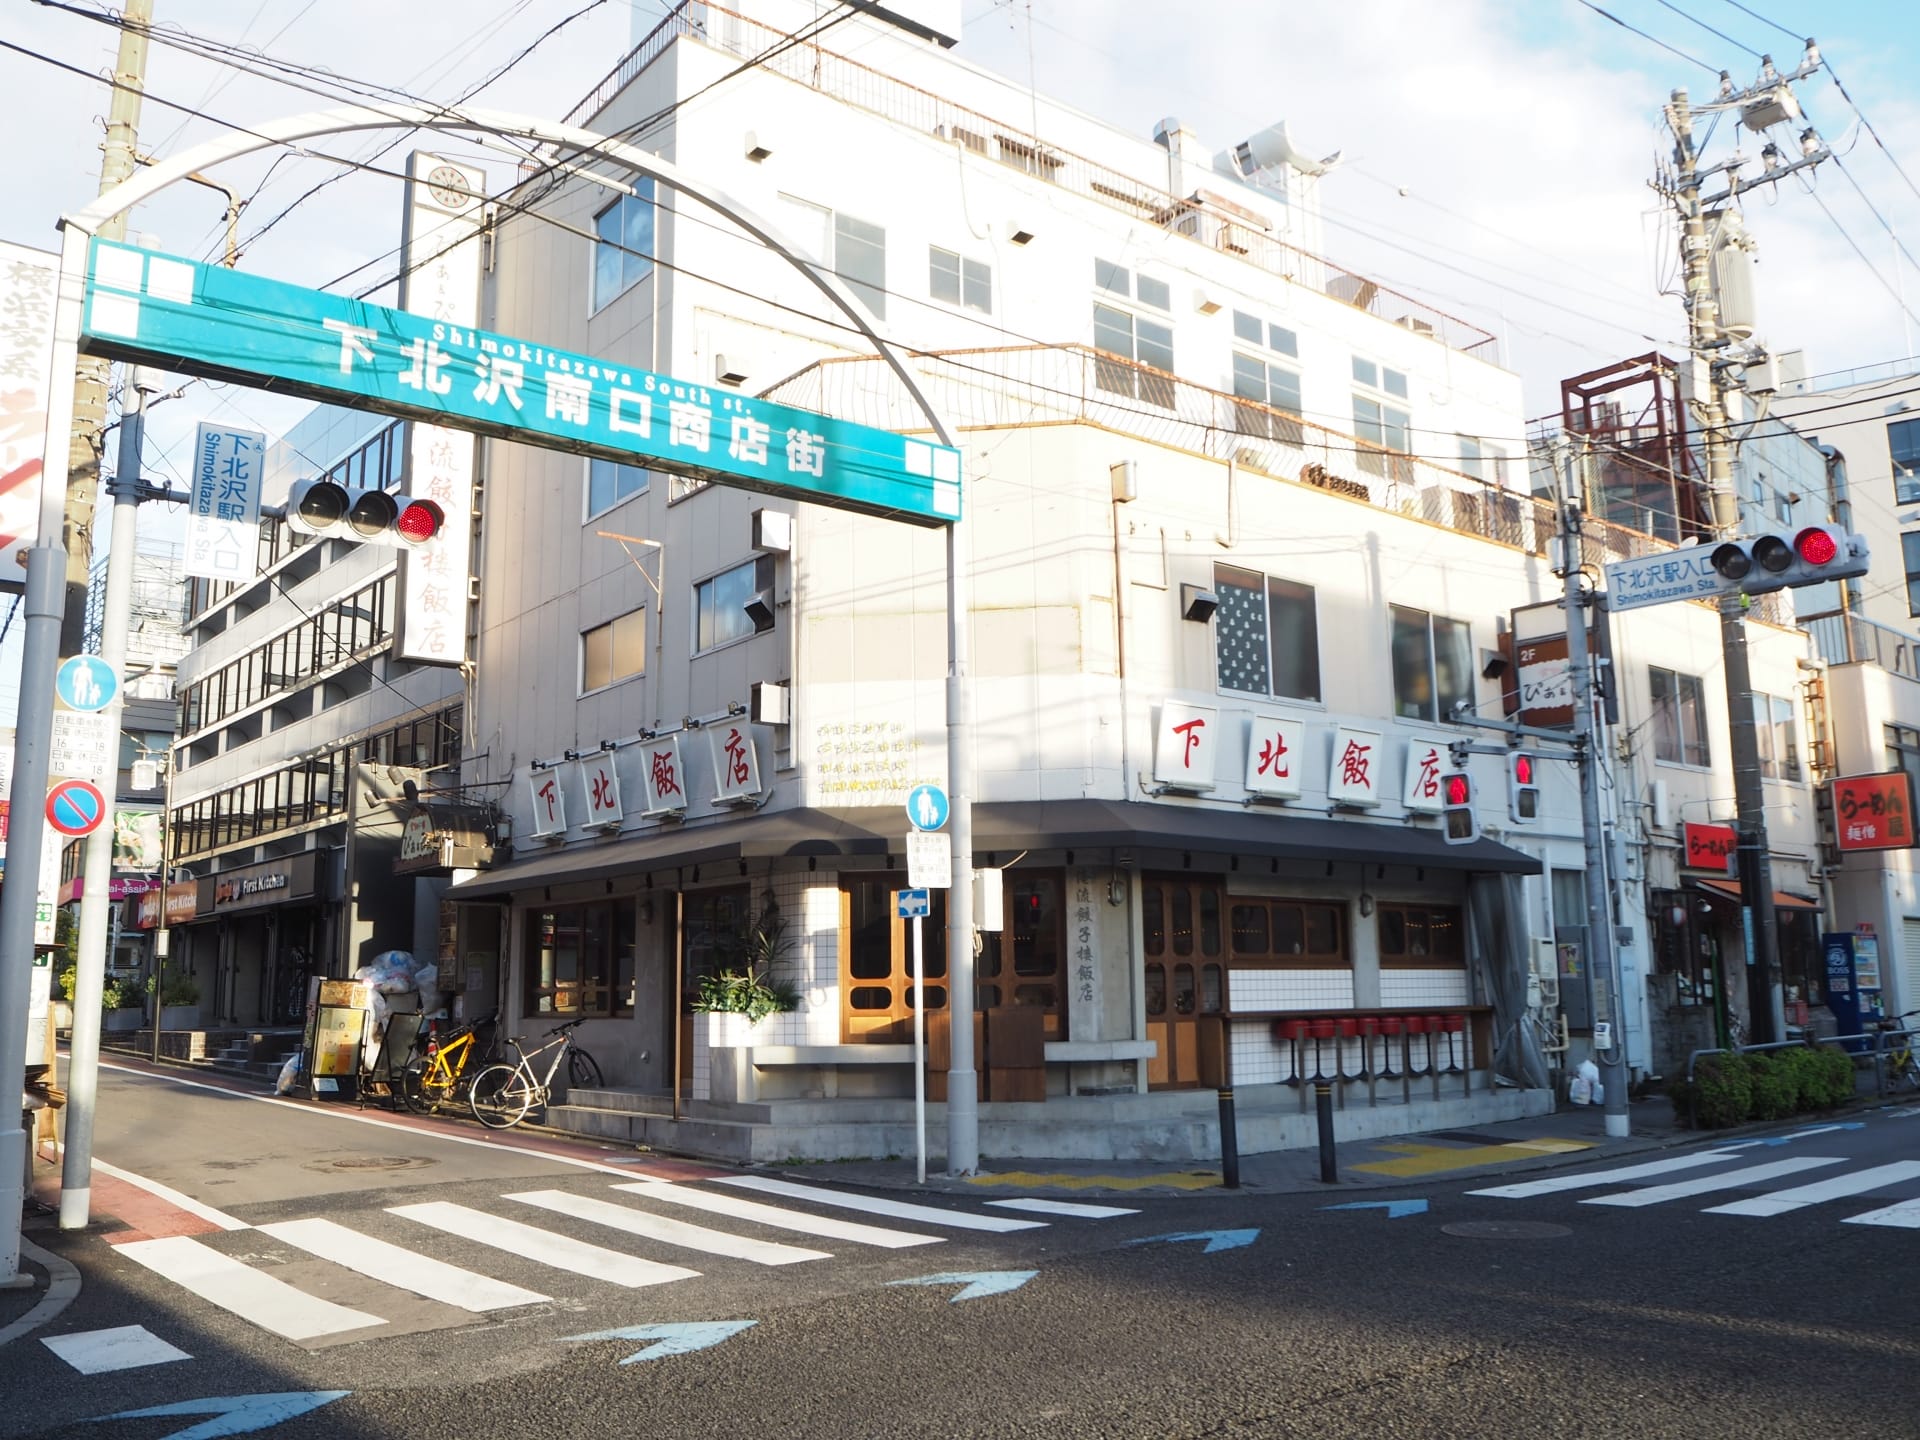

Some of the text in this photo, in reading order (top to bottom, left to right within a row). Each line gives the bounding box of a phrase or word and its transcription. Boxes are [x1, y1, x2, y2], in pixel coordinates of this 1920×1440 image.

[322, 317, 825, 478] 下北沢南口商店街
[433, 324, 751, 414] Shimokitazawa South st.
[194, 432, 221, 563] Shimokitazawa Sta.
[213, 432, 253, 571] 下北沢駅入口
[1612, 556, 1717, 592] 下北沢駅入口
[1616, 579, 1718, 606] Shimokitazawa Sta.
[1520, 648, 1536, 661] 2F
[538, 728, 750, 822] 下北飯店
[242, 878, 258, 895] First
[258, 873, 285, 892] Kitchen
[1827, 966, 1850, 975] BOSS
